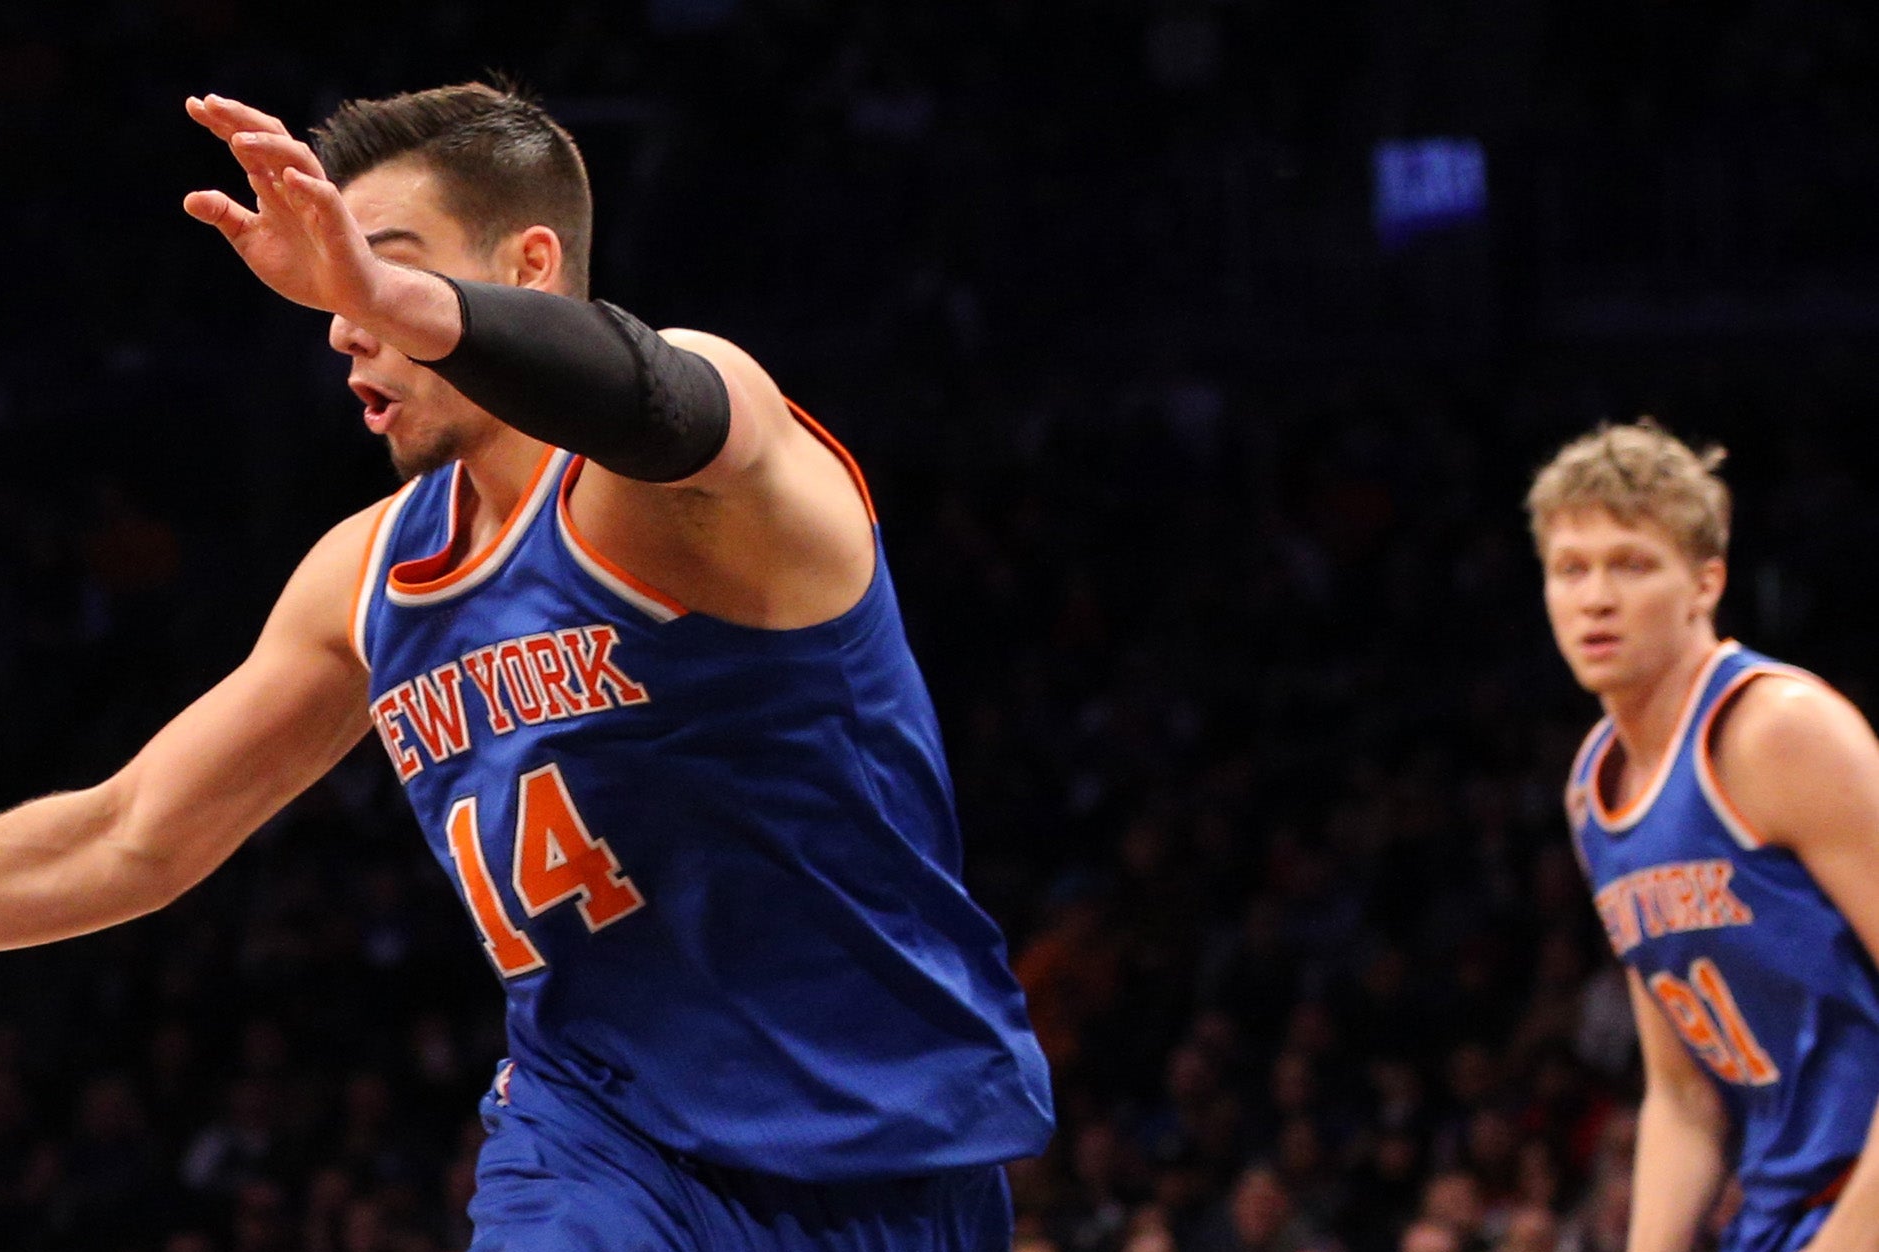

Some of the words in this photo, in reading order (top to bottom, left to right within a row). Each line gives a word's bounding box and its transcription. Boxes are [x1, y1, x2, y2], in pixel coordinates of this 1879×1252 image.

[369, 662, 472, 786] EW
[460, 623, 651, 736] YORK
[446, 762, 646, 979] 14
